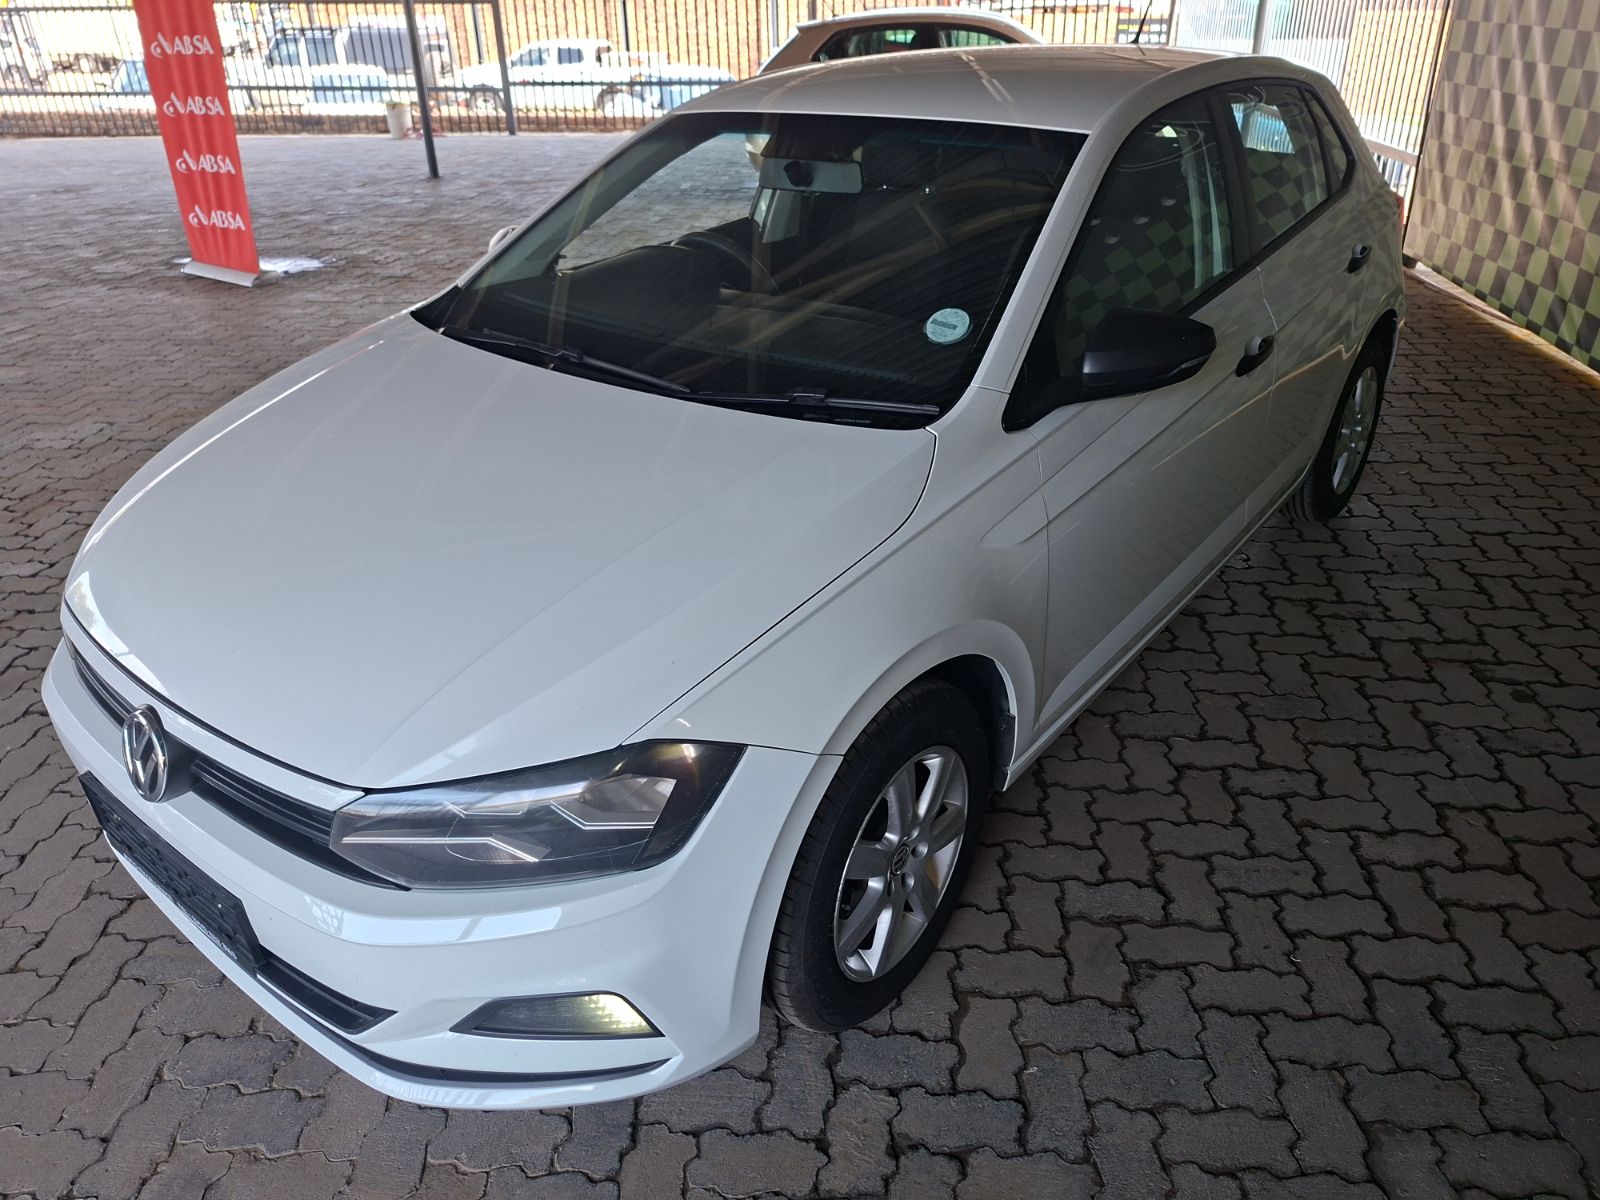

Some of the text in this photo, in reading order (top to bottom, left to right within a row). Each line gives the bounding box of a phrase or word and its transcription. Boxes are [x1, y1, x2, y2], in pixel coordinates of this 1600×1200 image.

[173, 35, 214, 55] ABSA
[186, 95, 225, 116] ABSA
[198, 153, 236, 175] ABSA
[209, 209, 246, 231] ABSA
